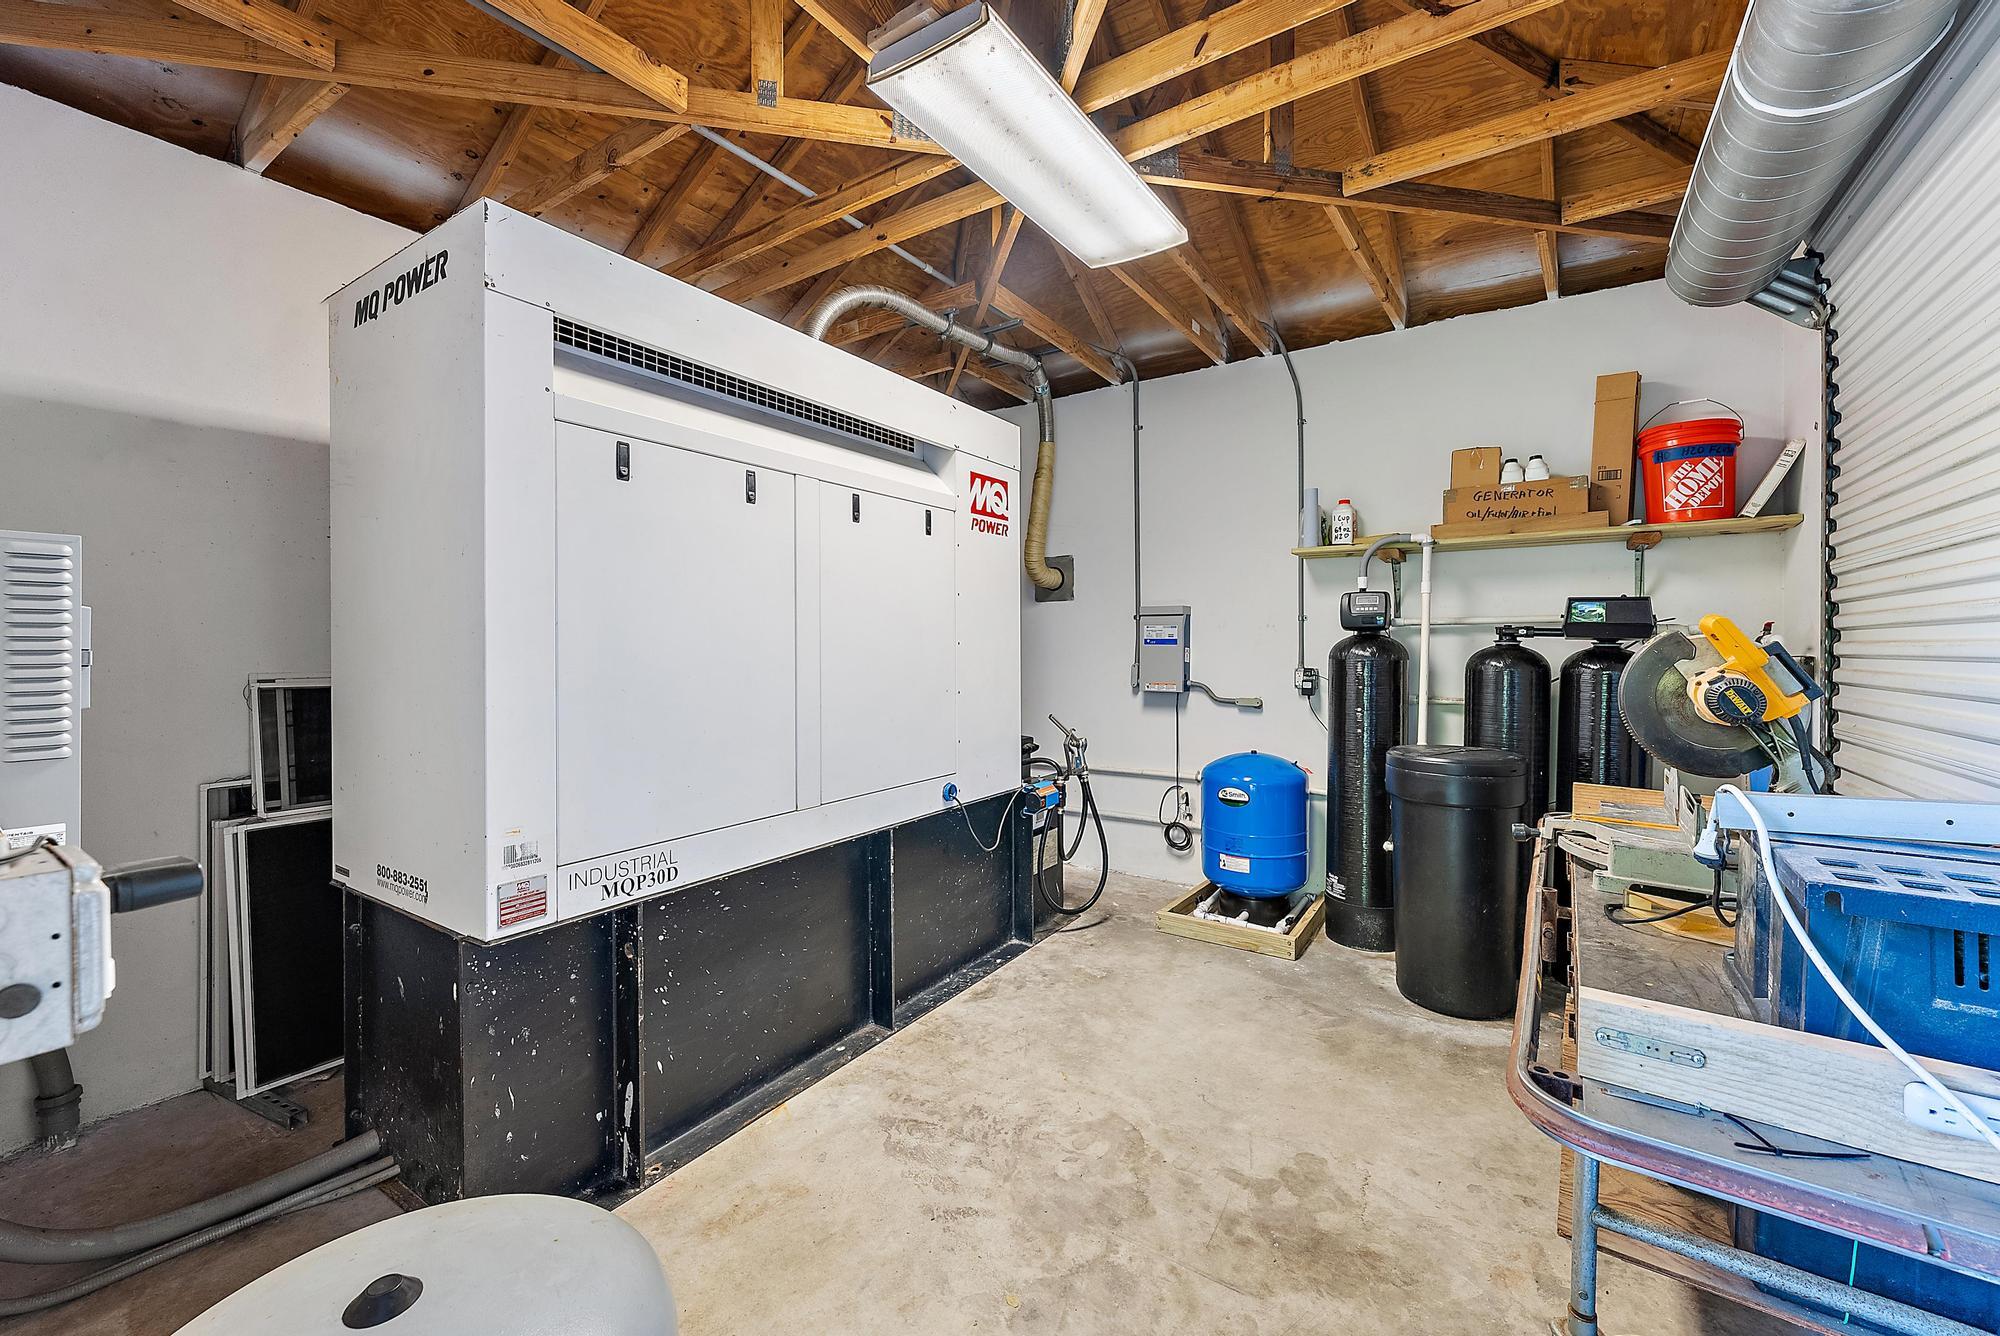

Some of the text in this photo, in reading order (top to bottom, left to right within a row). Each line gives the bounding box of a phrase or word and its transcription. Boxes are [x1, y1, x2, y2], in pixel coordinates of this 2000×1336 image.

[354, 250, 449, 328] MQ POWER
[1664, 456, 1724, 509] HOME
[1668, 460, 1696, 485] THE
[970, 477, 1009, 518] MQ
[1473, 488, 1554, 502] GENERATOR
[1688, 473, 1724, 508] DEPOT
[971, 517, 1009, 537] POWER
[1725, 688, 1753, 716] DEWALT
[569, 849, 679, 891] INDUSTRIAL
[600, 866, 679, 901] MQP30D
